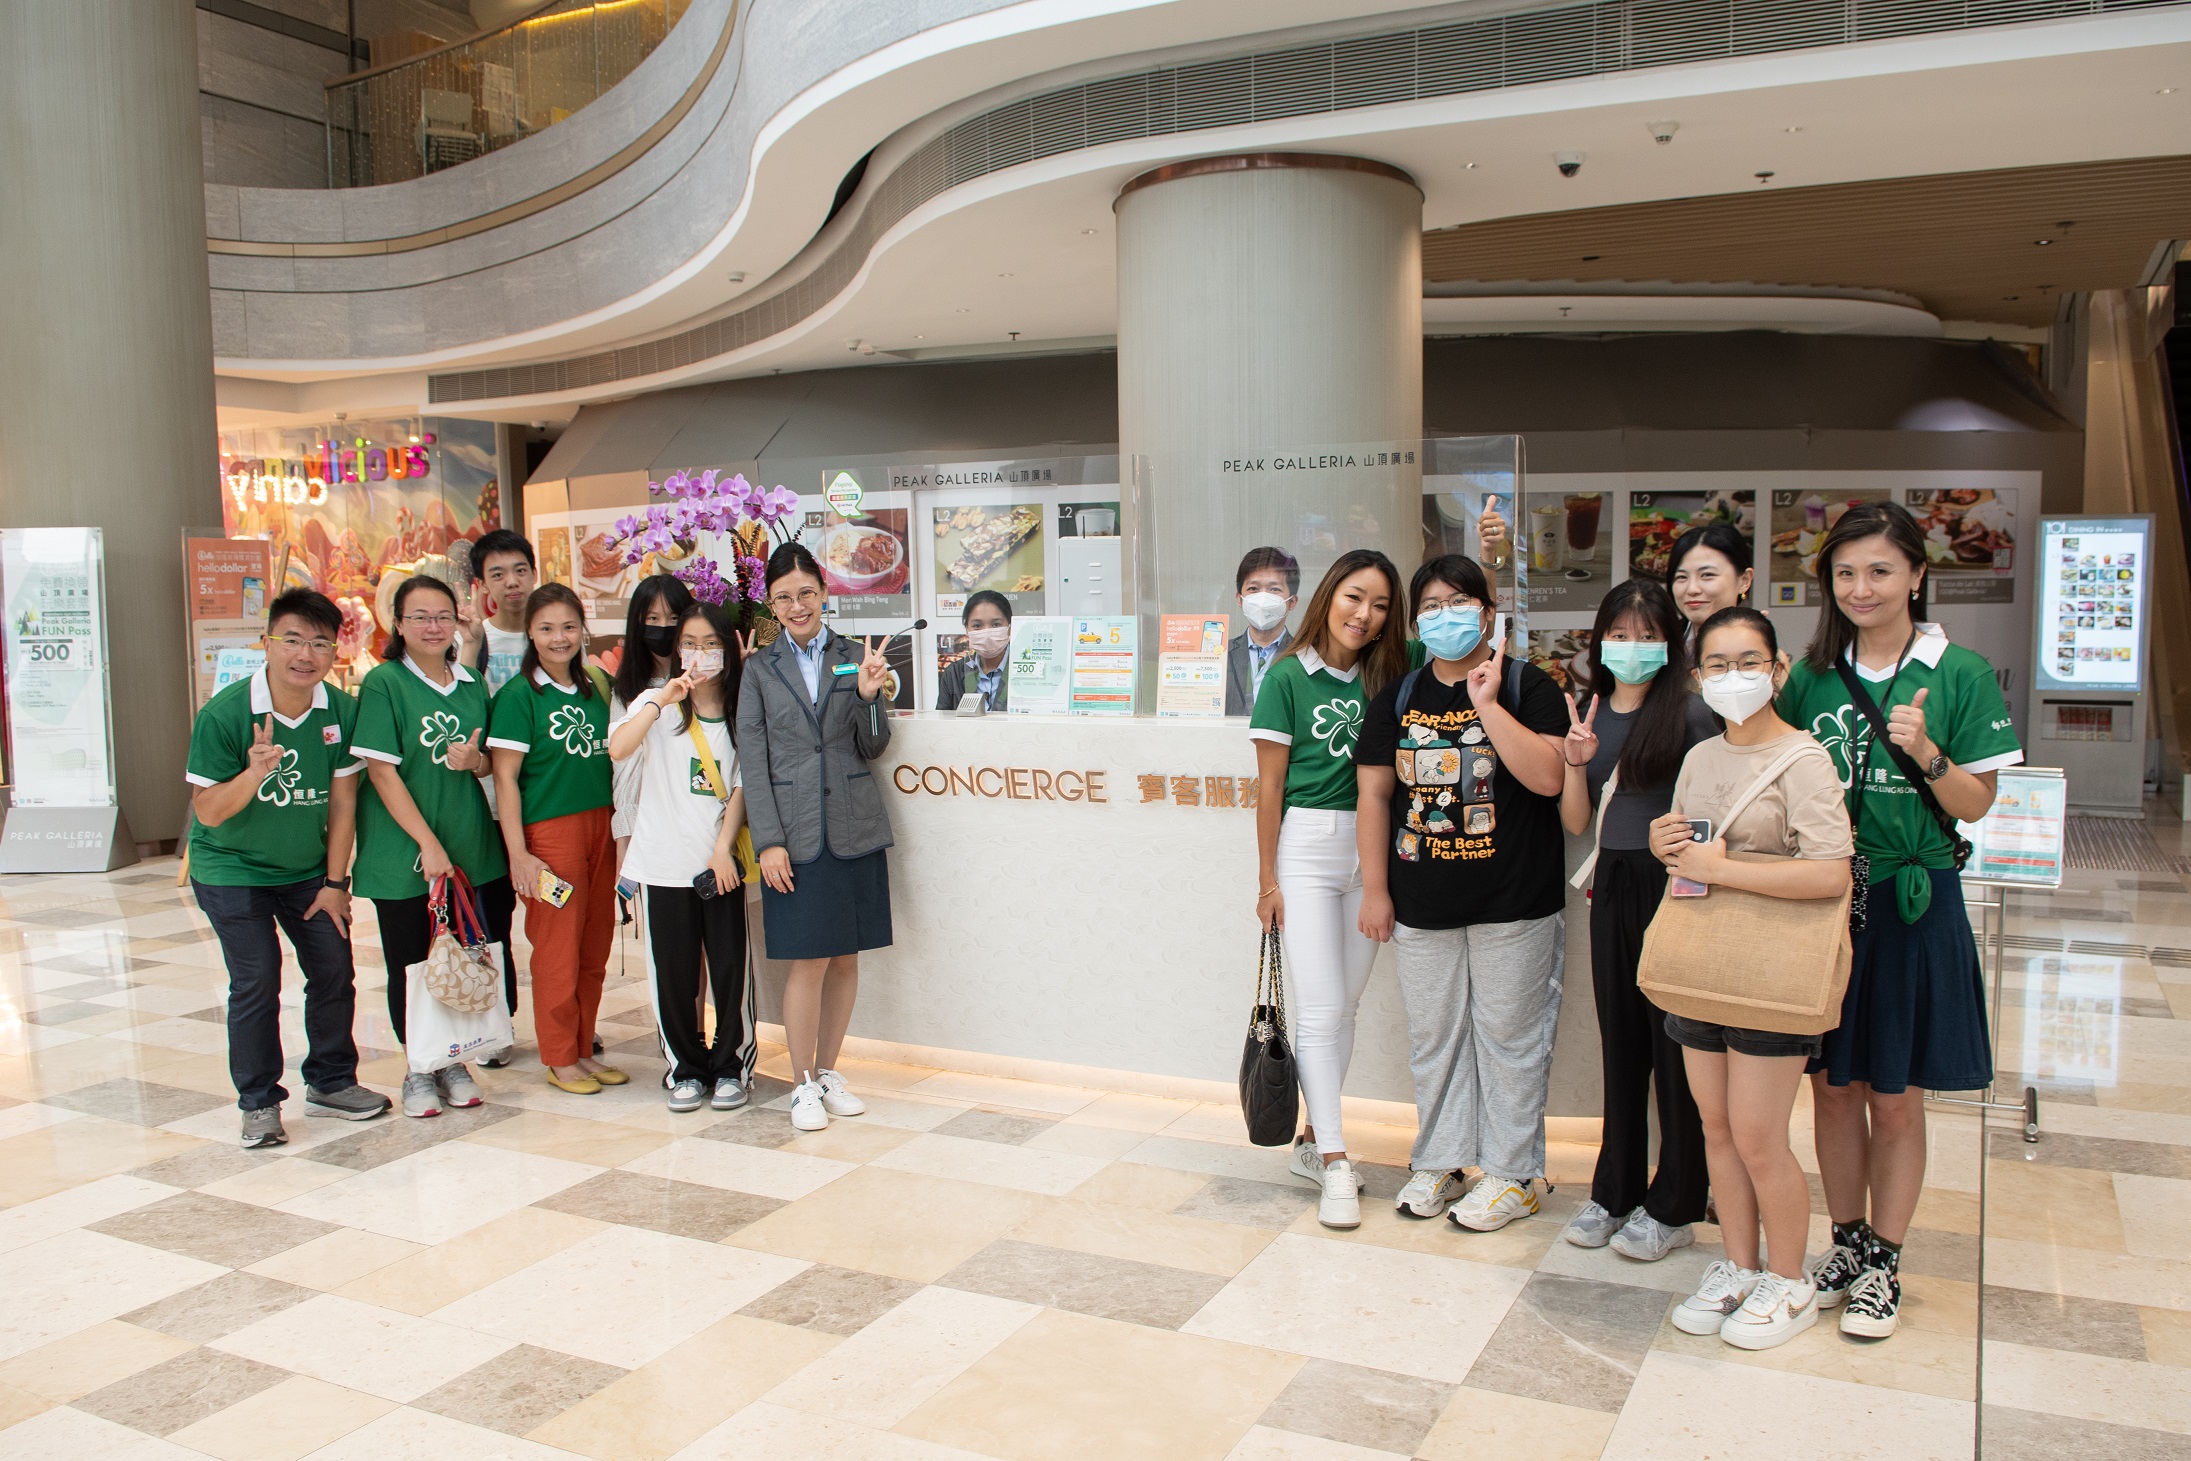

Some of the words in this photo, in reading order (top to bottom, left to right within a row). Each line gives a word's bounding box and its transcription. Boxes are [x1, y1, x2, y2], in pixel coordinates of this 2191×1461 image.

[1223, 459, 1265, 473] PEAK
[1273, 455, 1357, 470] GALLERIA
[1363, 451, 1425, 467] 山頂廣場
[893, 475, 928, 488] PEAK
[934, 472, 1003, 485] GALLERIA
[1009, 469, 1052, 482] 山頂廣場
[1633, 494, 1650, 507] L2
[1774, 492, 1792, 505] L2
[936, 510, 950, 522] L2
[1058, 506, 1073, 519] L2
[808, 514, 822, 526] L2
[197, 562, 247, 573] hellodollar
[864, 597, 876, 605] Bing
[42, 627, 65, 636] FUN
[68, 626, 91, 636] Pass
[1109, 627, 1121, 645] 5
[940, 636, 952, 649] L1
[893, 763, 1111, 804] CONCIERGE
[1136, 773, 1262, 808] 賓客服務
[10, 831, 41, 841] PEAK
[46, 831, 104, 840] GALLERIA
[1425, 836, 1451, 849] The
[1454, 835, 1492, 850] Best
[1431, 848, 1496, 860] Partner
